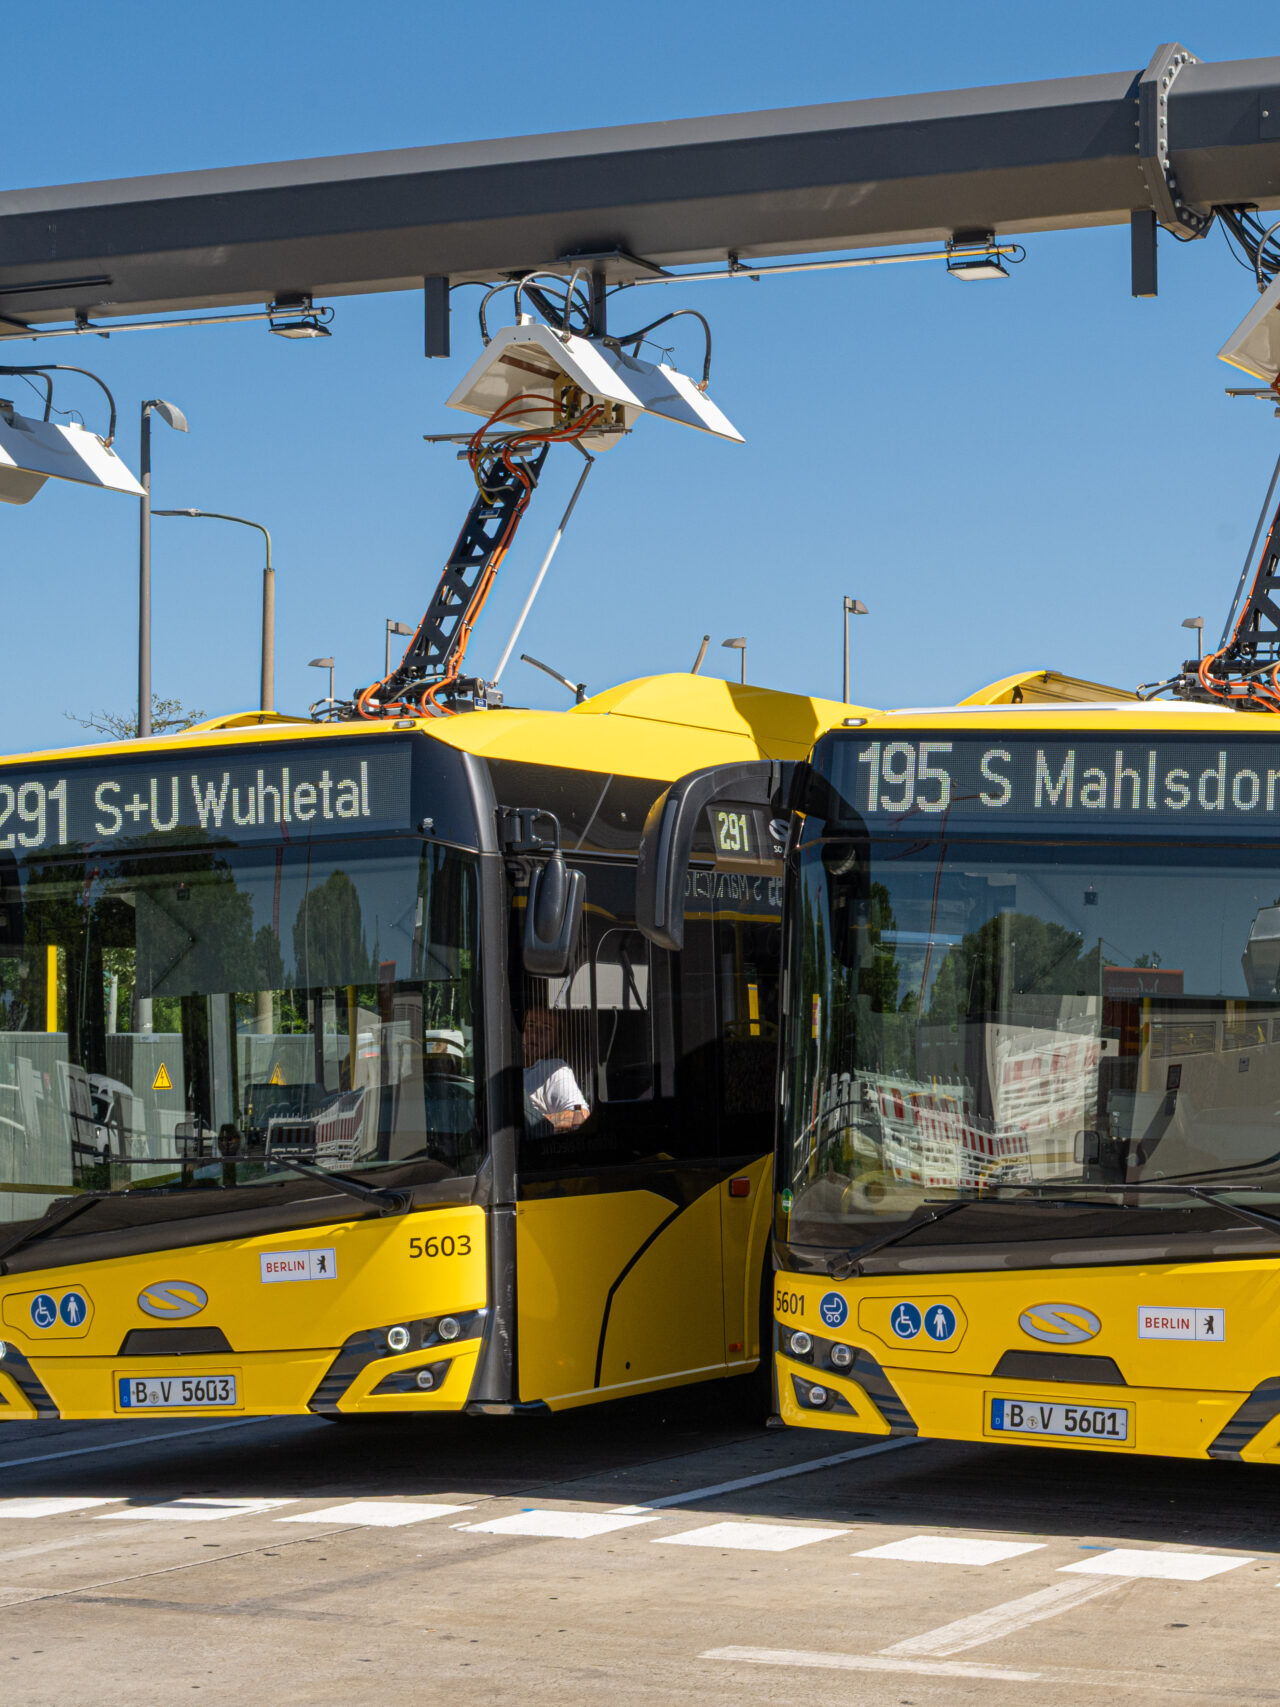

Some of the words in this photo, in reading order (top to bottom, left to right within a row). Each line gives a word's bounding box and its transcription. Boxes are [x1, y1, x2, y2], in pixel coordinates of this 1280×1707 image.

[858, 741, 953, 812] 195
[979, 749, 1012, 807] S
[95, 776, 180, 835] S+U
[191, 761, 371, 828] Wuhletal
[717, 811, 749, 851] 291
[409, 1235, 472, 1259] 5603
[265, 1260, 305, 1273] BERLIN
[776, 1290, 805, 1316] 5601
[1145, 1317, 1190, 1330] BERLIN
[135, 1381, 148, 1403] B
[160, 1381, 172, 1403] V
[182, 1379, 230, 1402] 5603
[1010, 1404, 1024, 1428] B
[1040, 1406, 1053, 1430] V
[1064, 1408, 1120, 1436] 5601
